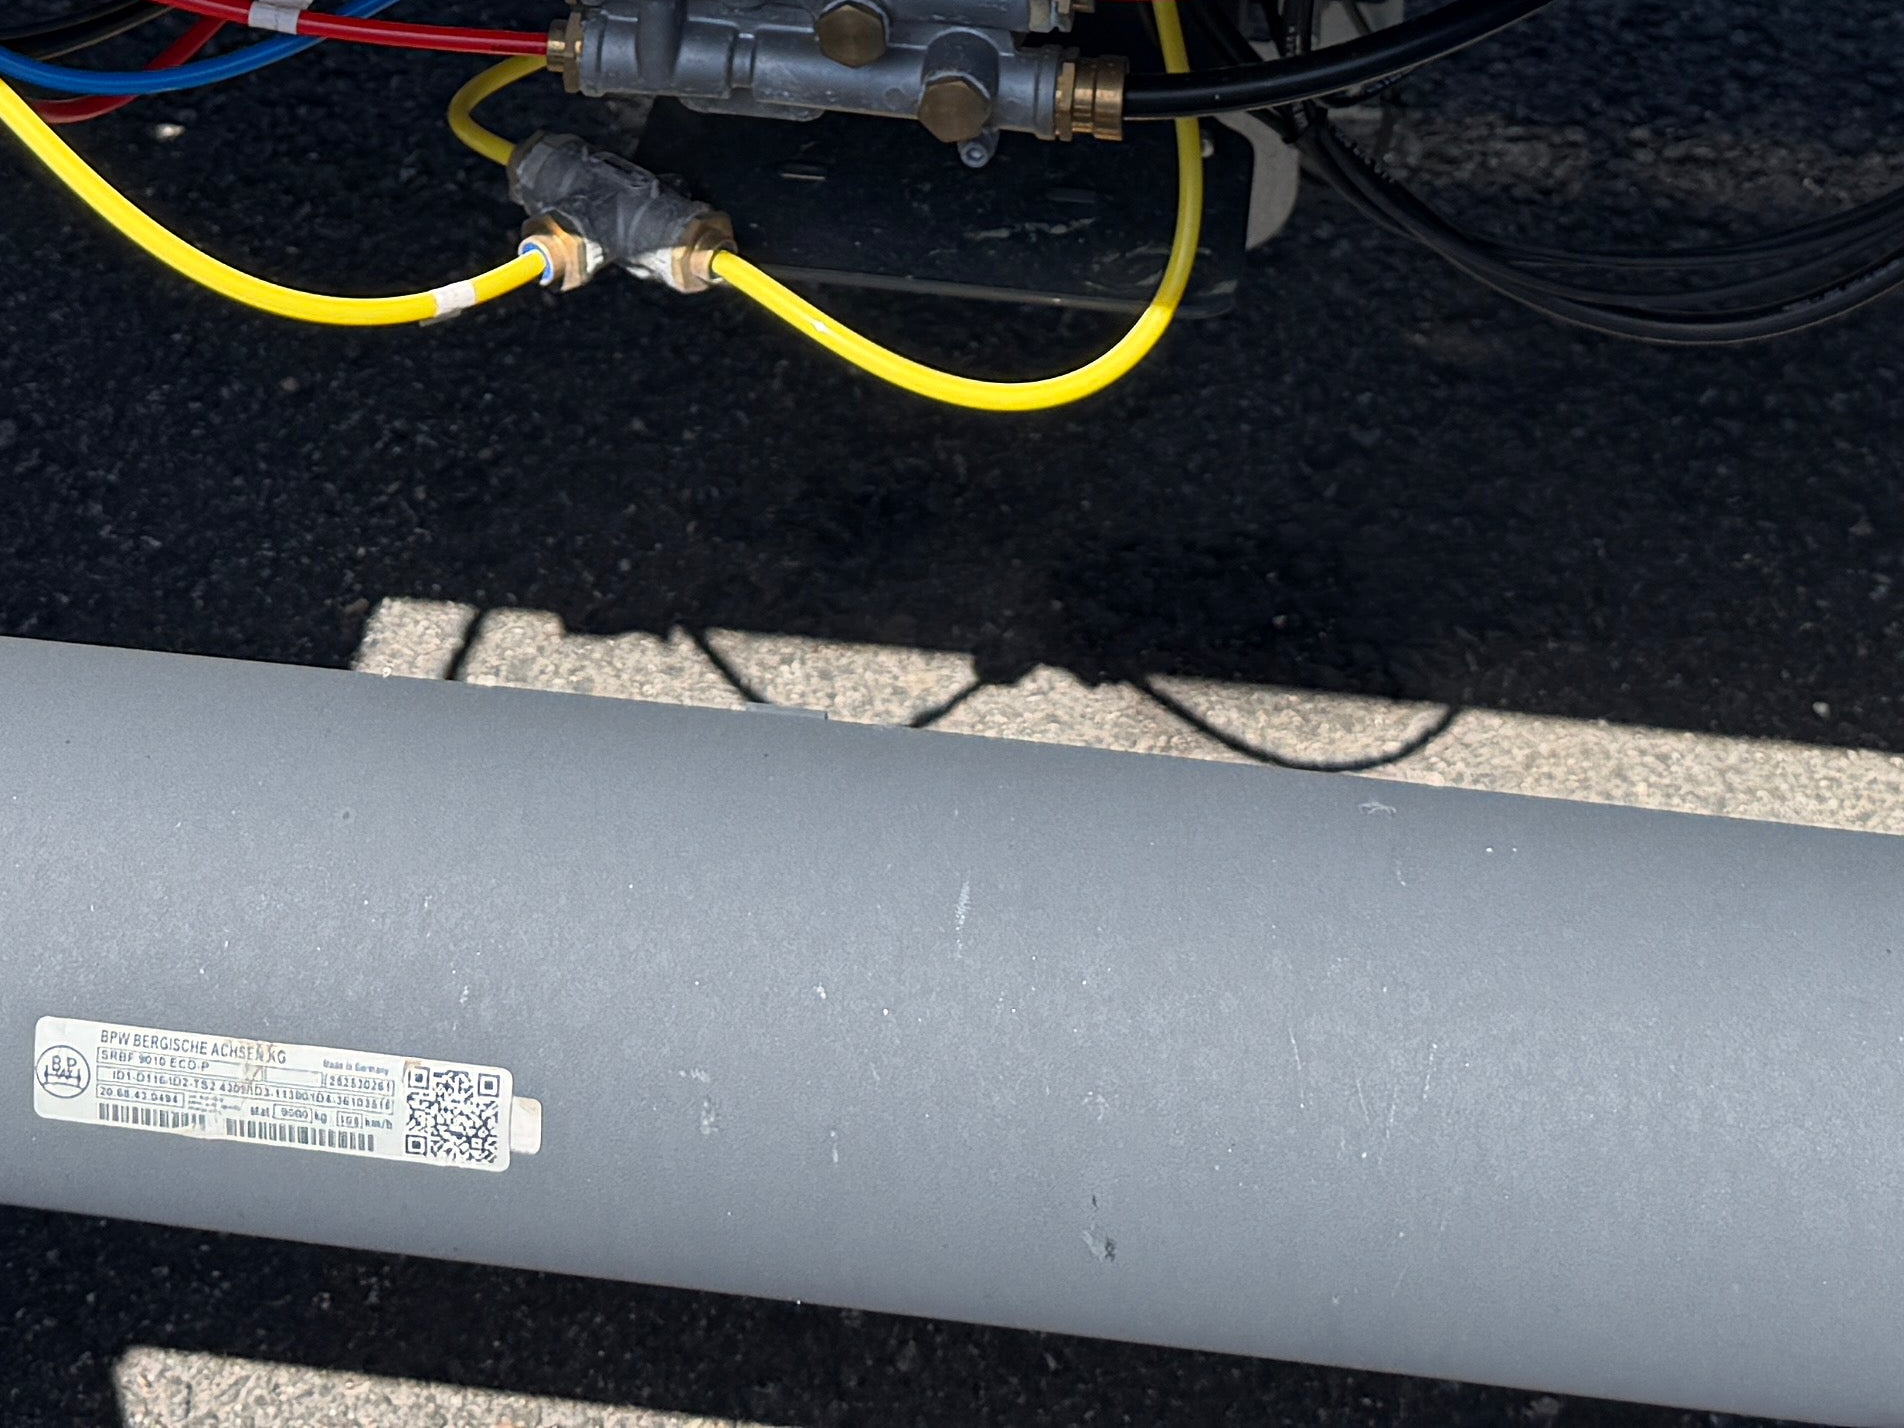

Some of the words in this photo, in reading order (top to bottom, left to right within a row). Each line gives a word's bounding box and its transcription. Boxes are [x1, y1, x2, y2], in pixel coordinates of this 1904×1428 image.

[100, 1029, 129, 1046] BPW
[133, 1033, 207, 1055] BERGISCHE
[211, 1042, 264, 1062] ACHSEN
[266, 1048, 286, 1064] KG
